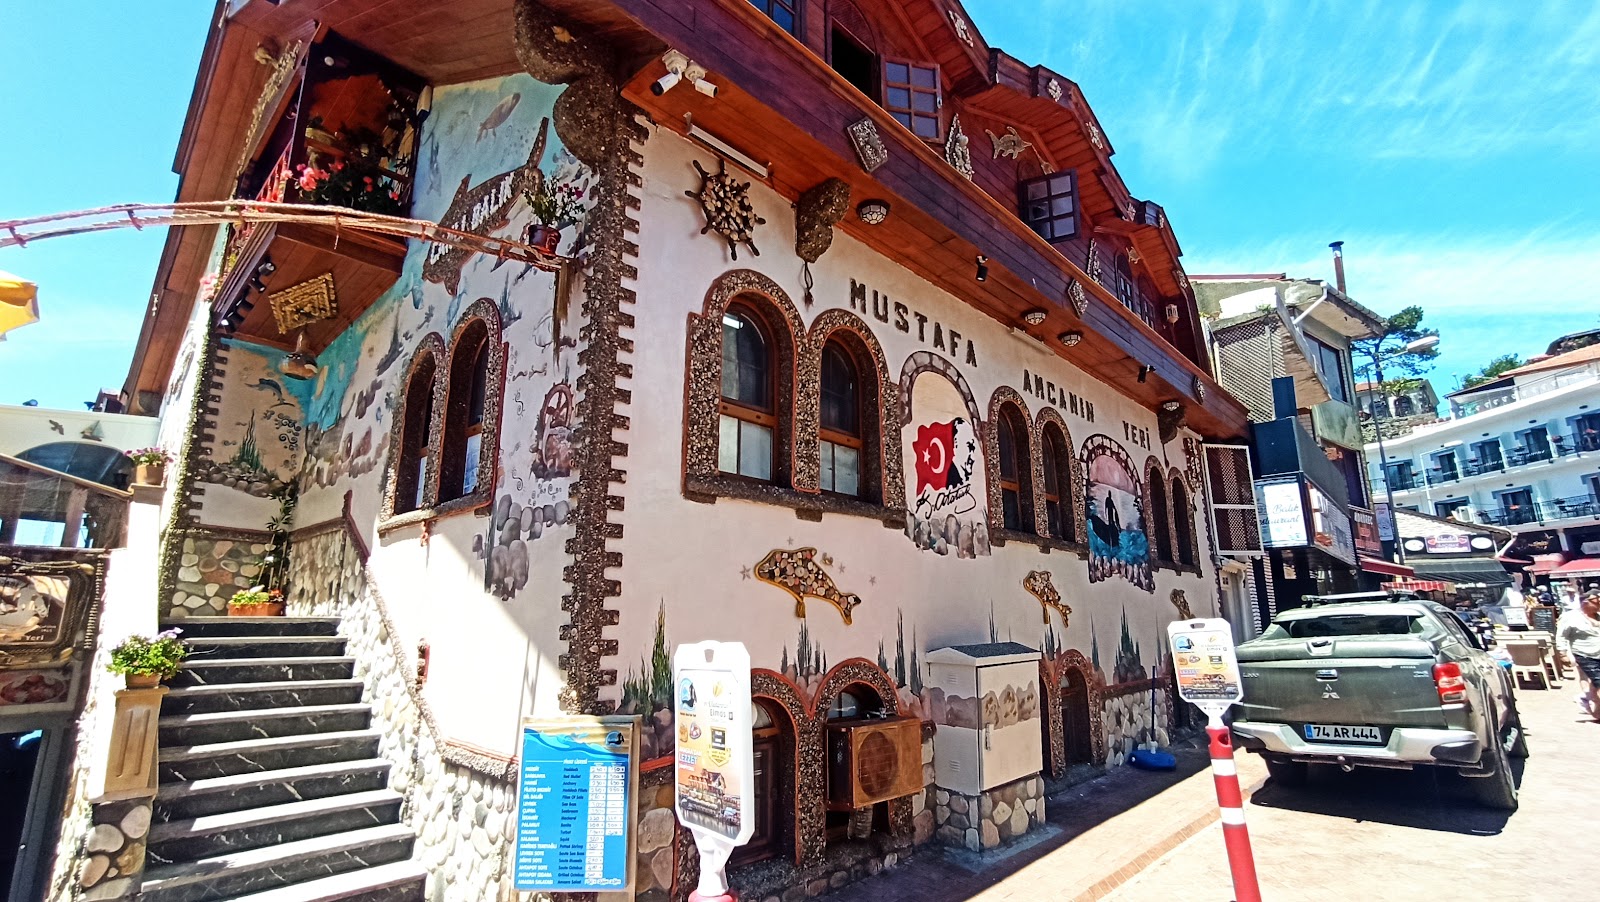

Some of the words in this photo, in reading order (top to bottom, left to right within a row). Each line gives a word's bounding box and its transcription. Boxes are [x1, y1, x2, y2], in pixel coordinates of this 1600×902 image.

[850, 277, 978, 368] MUSTAFA
[1023, 369, 1095, 423] AMCANIN
[1122, 420, 1151, 451] YERİ
[1313, 726, 1330, 737] 74
[1334, 727, 1350, 738] AR
[1352, 728, 1378, 739] 444
